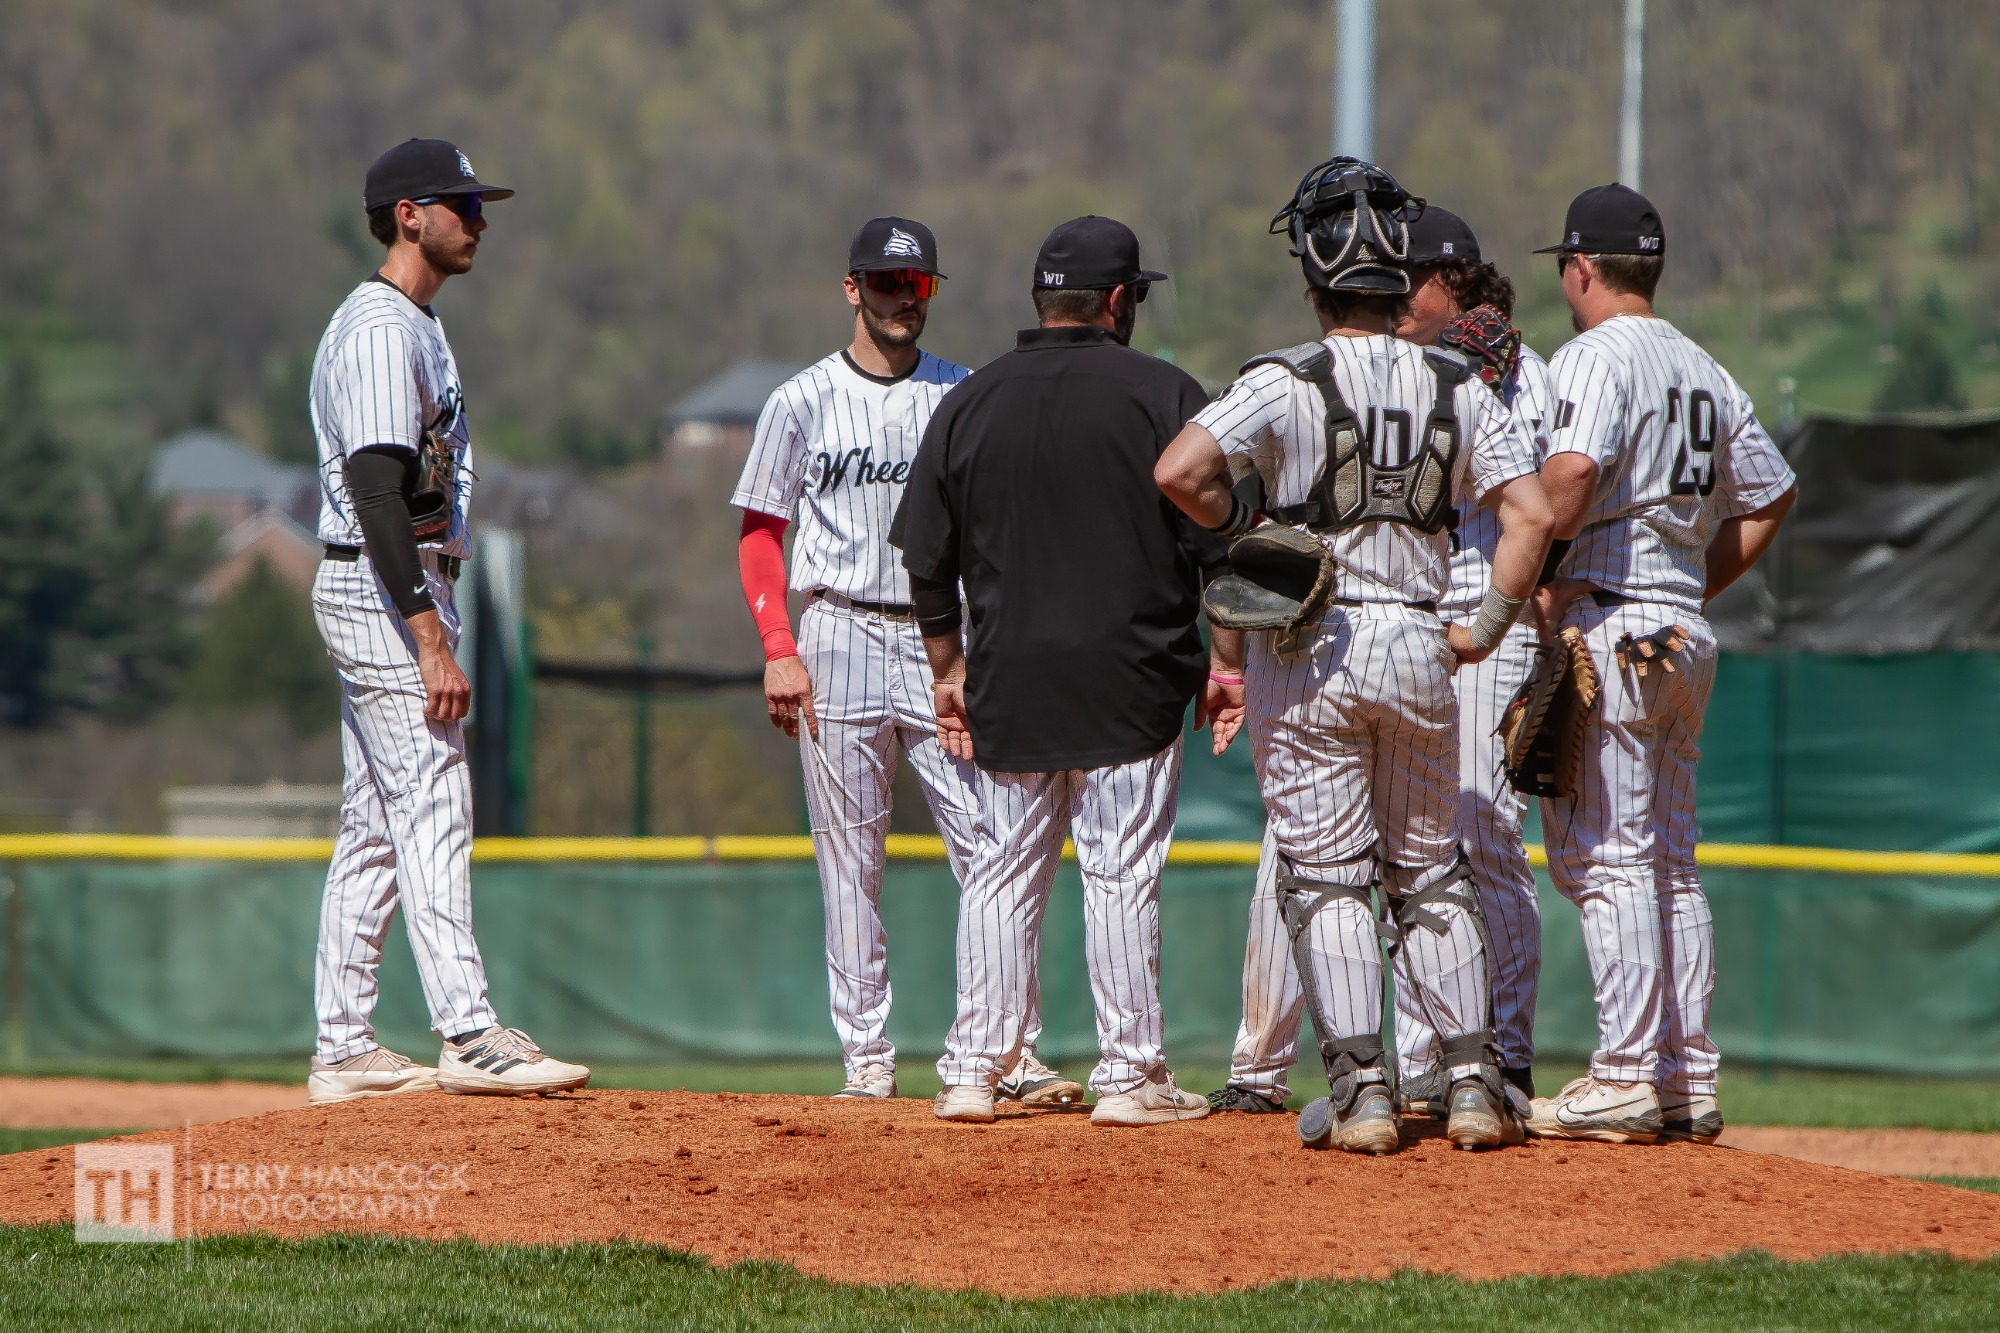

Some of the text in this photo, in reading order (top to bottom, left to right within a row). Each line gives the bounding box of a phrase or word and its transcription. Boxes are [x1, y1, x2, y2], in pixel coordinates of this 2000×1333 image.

[1639, 236, 1660, 249] WU
[1043, 271, 1065, 285] WU
[1667, 386, 1718, 496] 29
